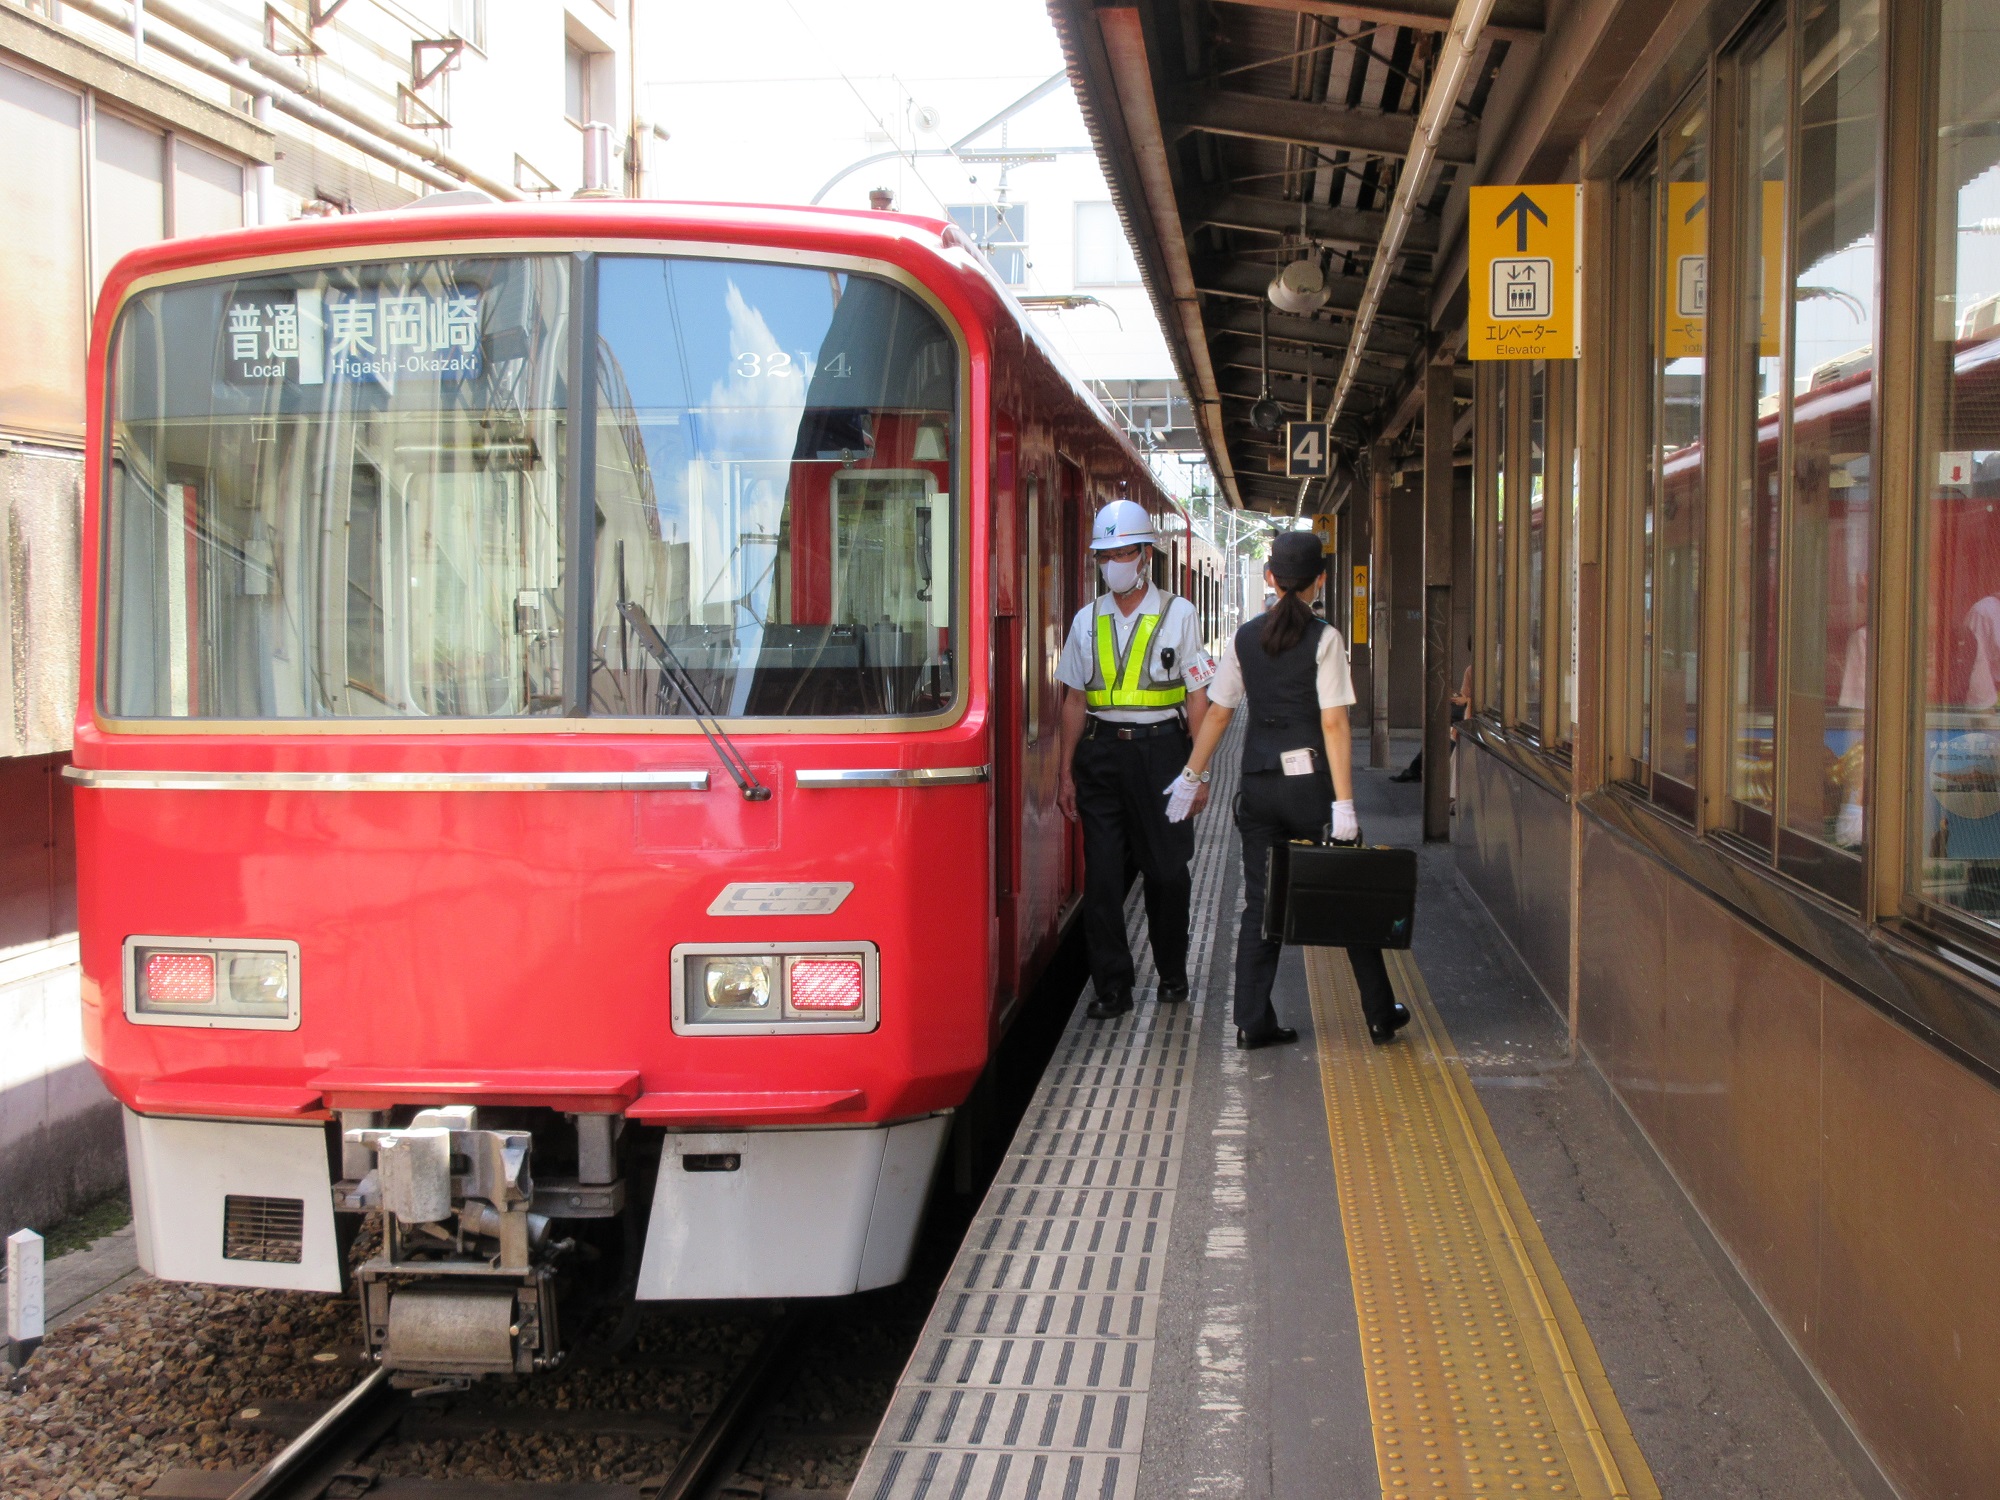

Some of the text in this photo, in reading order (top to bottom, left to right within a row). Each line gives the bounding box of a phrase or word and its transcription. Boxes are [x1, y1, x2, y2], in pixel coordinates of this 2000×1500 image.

[229, 303, 299, 360] 普通
[329, 295, 478, 355] 東岡崎
[1485, 324, 1558, 341] エレベーター
[1496, 344, 1546, 355] Elevator
[243, 362, 286, 378] Local
[332, 355, 476, 378] Higashi-Okazaki
[736, 351, 852, 378] 3214
[1292, 431, 1323, 468] 4
